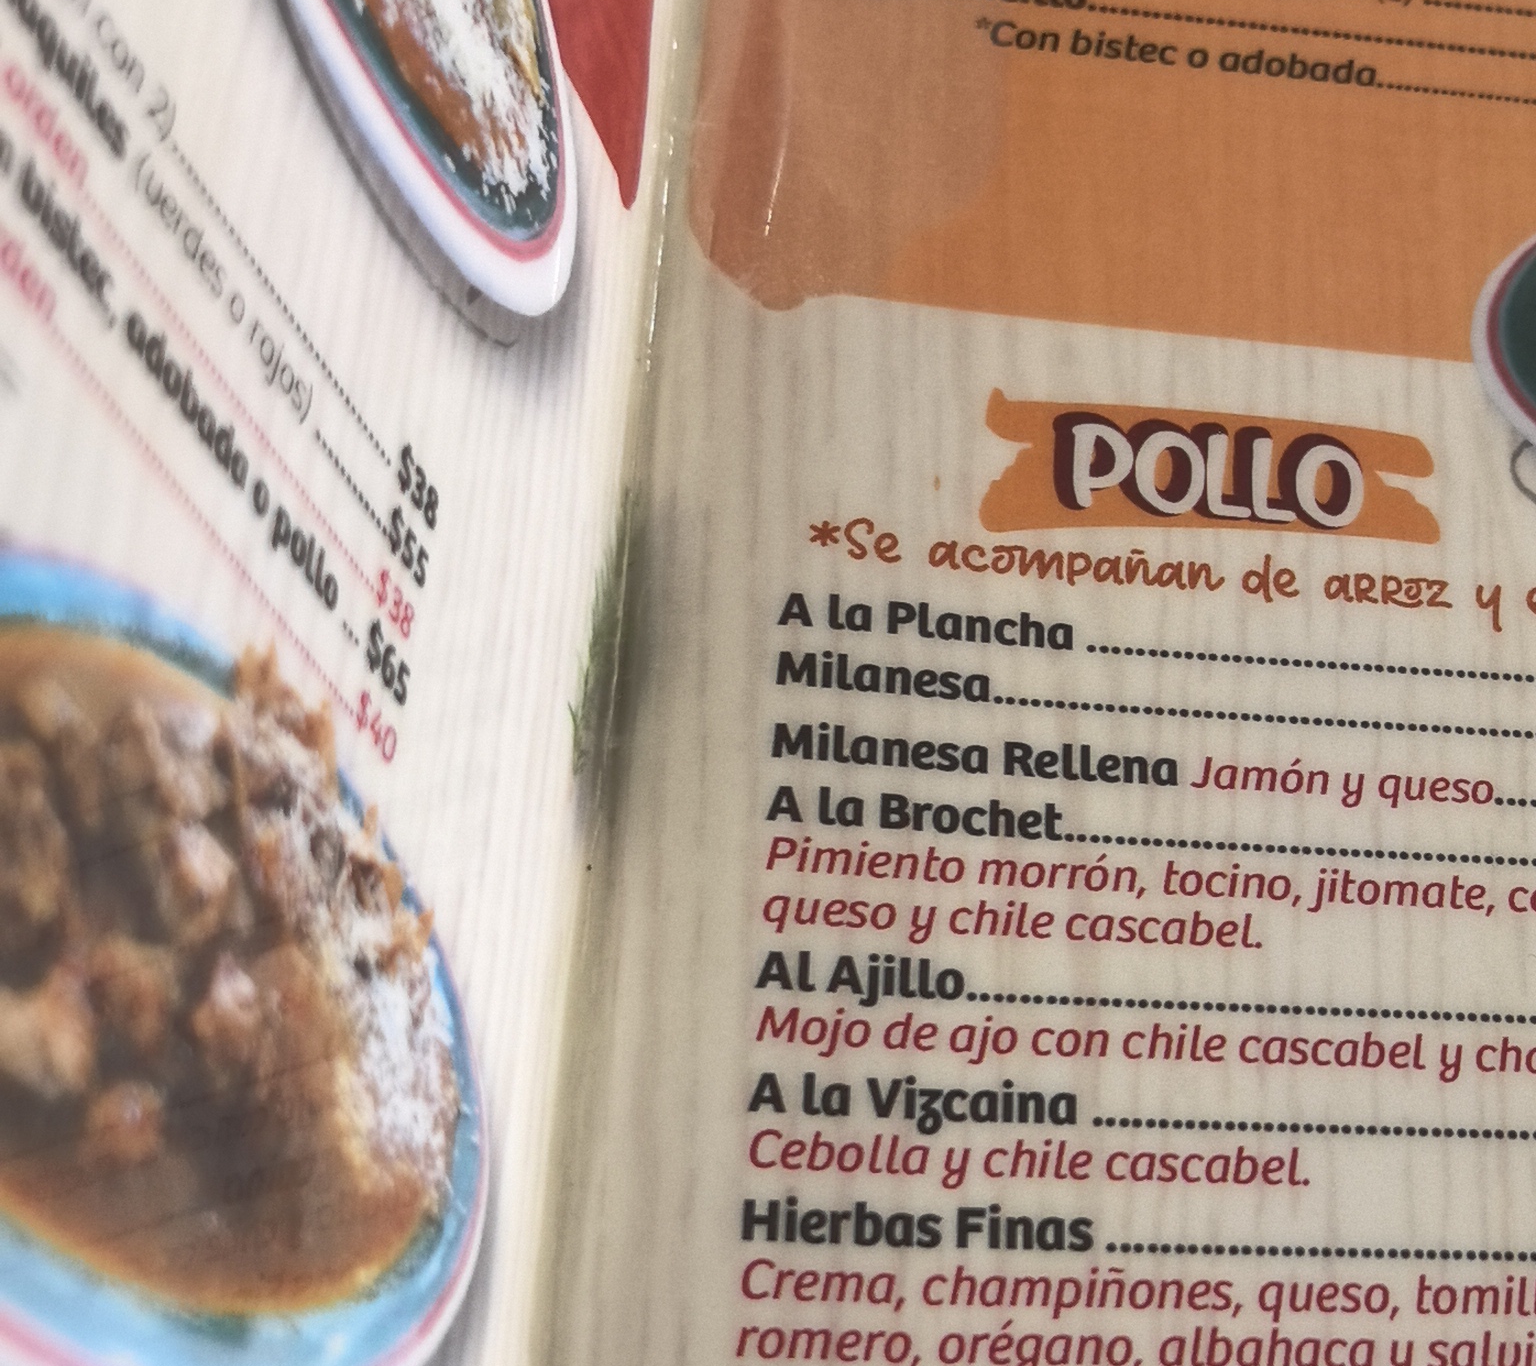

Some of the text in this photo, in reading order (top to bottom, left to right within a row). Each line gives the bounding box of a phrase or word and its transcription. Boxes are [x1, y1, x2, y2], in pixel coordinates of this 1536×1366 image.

[1069, 28, 1178, 66] bistec
[1187, 45, 1210, 69] o
[397, 442, 439, 531] $38
[1056, 413, 1366, 529] POLLO
[125, 310, 411, 706] adobada o pollo $65
[387, 505, 430, 588] $55
[375, 569, 414, 640] $38
[927, 540, 1226, 592] acompañan
[1240, 553, 1301, 604] de
[1474, 584, 1503, 634] y
[776, 591, 814, 628] A
[826, 592, 874, 633] la
[884, 599, 1075, 655] Plancha
[777, 651, 991, 705] Milanesa
[356, 690, 398, 764] $40
[1003, 741, 1178, 787] Rellena
[1191, 751, 1330, 796] Jamón
[1340, 772, 1366, 809] y
[1378, 773, 1494, 810] queso
[765, 835, 966, 884] Pimiento
[977, 853, 1147, 900] morrón,
[1163, 861, 1300, 908] tocino,
[1311, 869, 1496, 917] jitomate,
[828, 955, 965, 1007] Ajillo
[1238, 1030, 1426, 1071] cascabel
[1440, 1044, 1466, 1084] y
[865, 1074, 1079, 1137] Vizcaina
[740, 1197, 1094, 1253] Hierbas Finas
[739, 1257, 906, 1315] Crema,
[923, 1265, 1244, 1321] champiñones,
[1258, 1280, 1400, 1321] queso,
